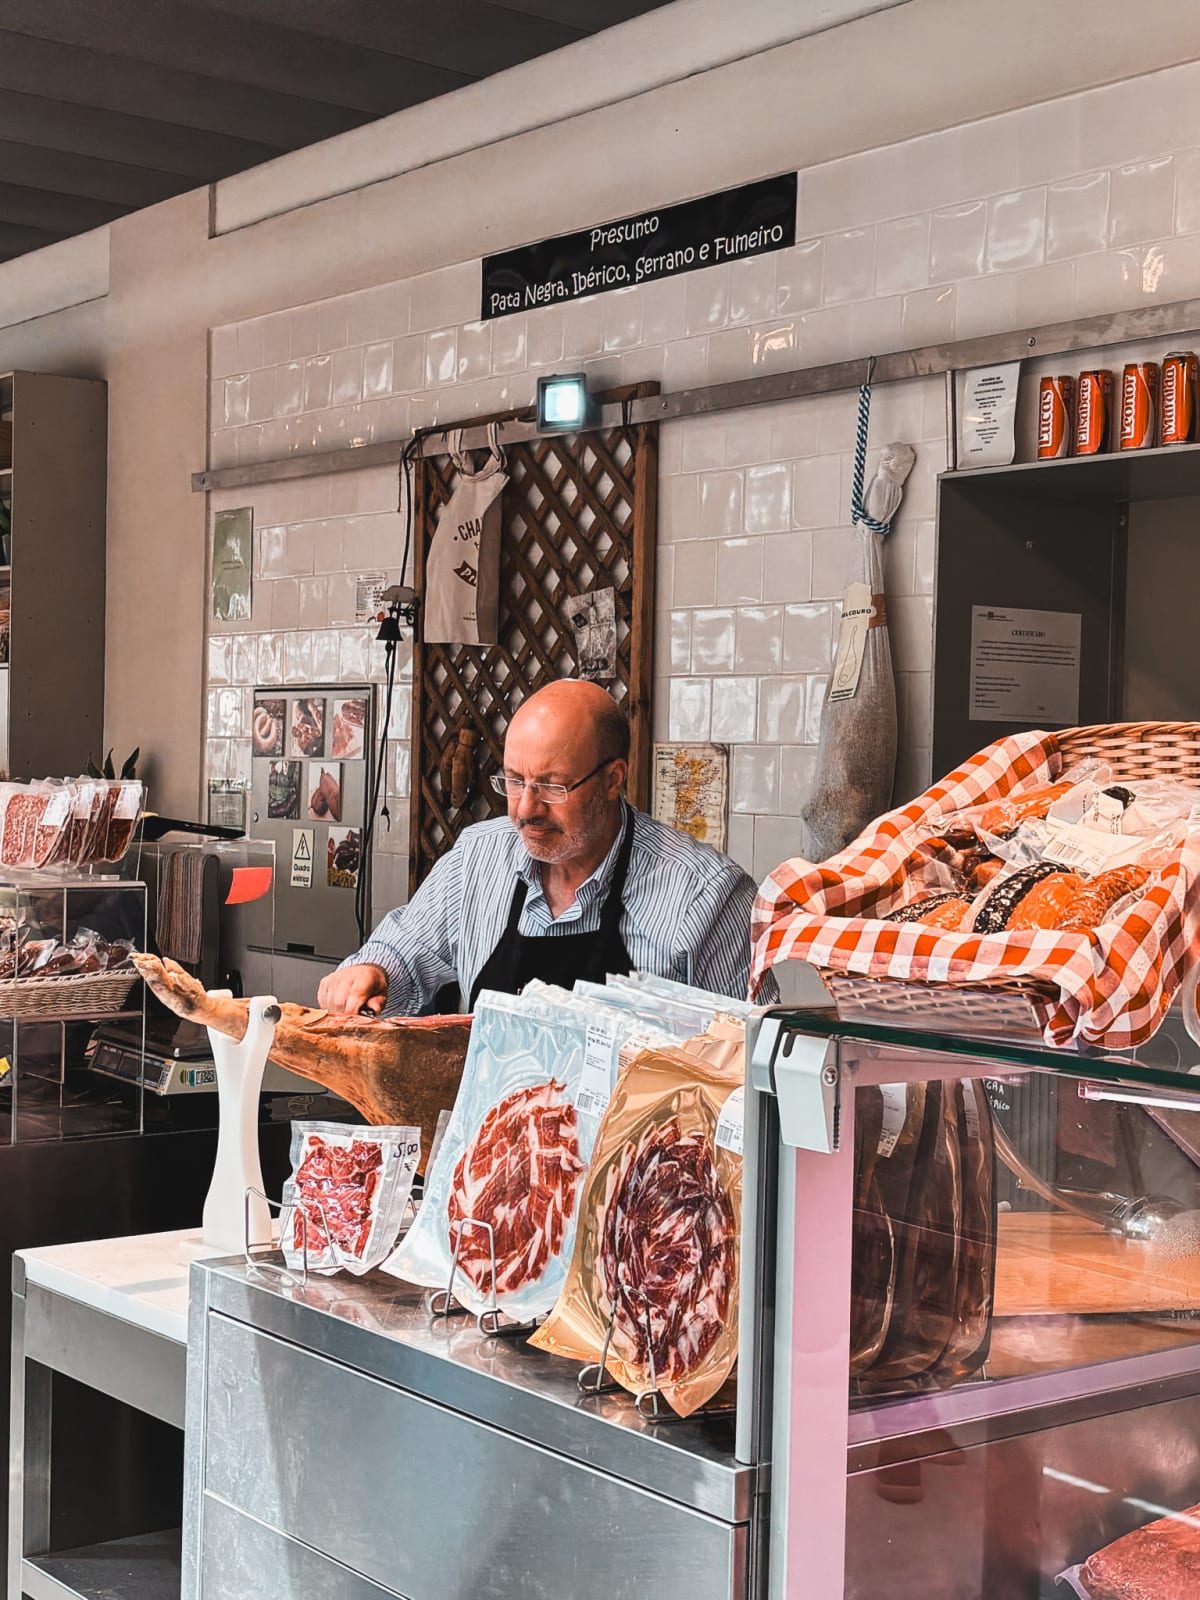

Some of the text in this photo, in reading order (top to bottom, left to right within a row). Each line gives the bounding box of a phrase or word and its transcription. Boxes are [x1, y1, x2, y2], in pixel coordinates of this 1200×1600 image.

[590, 217, 659, 251] Presunto
[490, 225, 783, 315] Pata Negra, Ibérico, Serrano e Fumeiro
[1039, 390, 1053, 447] Lucas
[1078, 378, 1091, 445] Elisabete
[1120, 374, 1136, 439] Leonor
[458, 518, 483, 541] CHA
